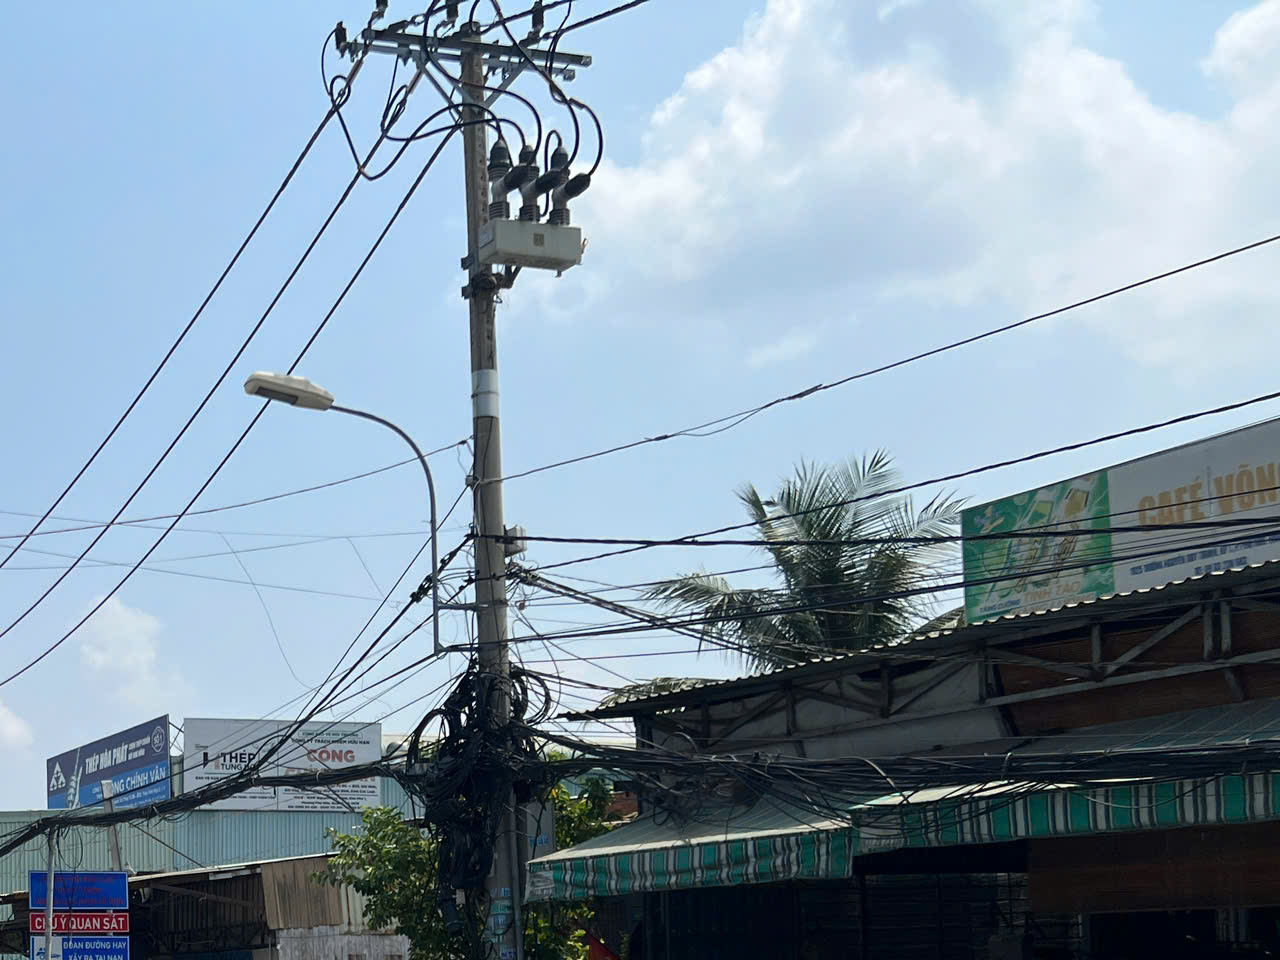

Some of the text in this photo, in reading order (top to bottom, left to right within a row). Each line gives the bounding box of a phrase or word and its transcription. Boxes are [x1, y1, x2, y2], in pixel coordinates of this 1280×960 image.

[1138, 463, 1280, 534] CAFÉ VÕN
[85, 753, 100, 775] THÉP
[112, 742, 128, 766] PHÁT
[221, 749, 256, 763] THÉP
[60, 914, 67, 929] Ý
[70, 918, 101, 930] QUAN
[103, 913, 125, 929] SÁT
[112, 941, 126, 949] HAY
